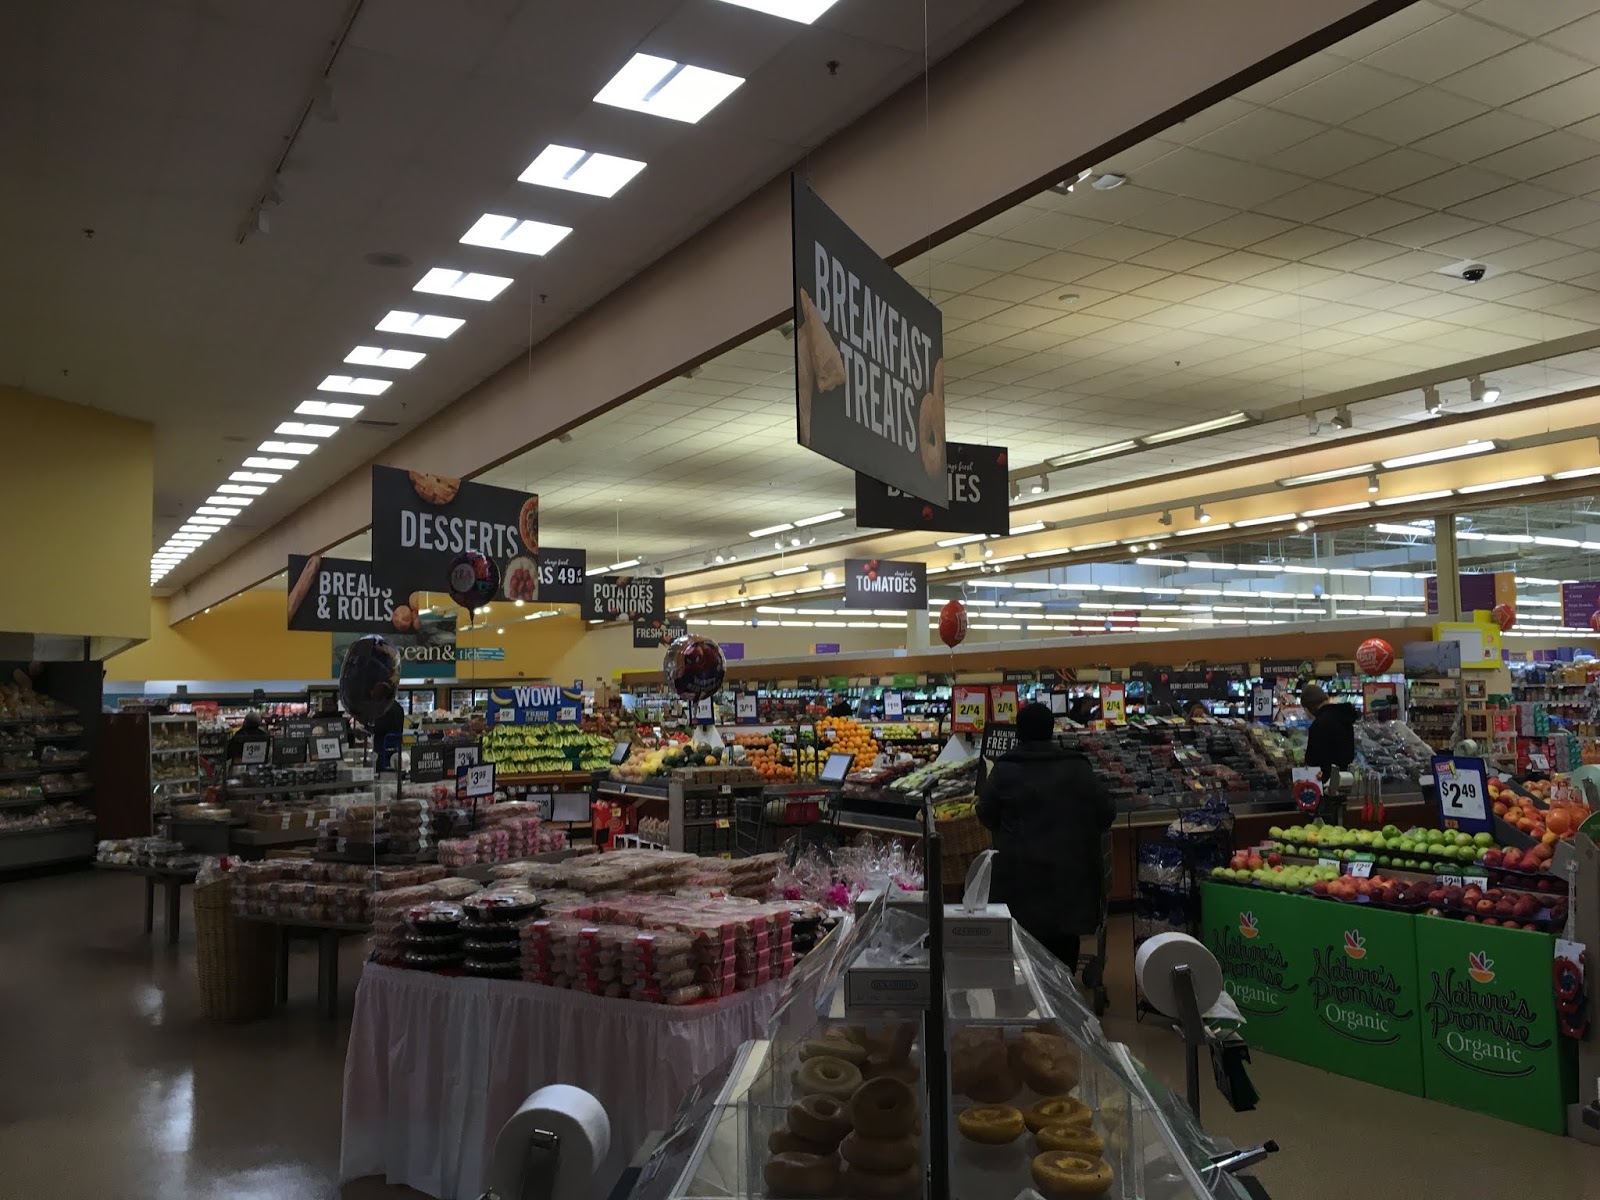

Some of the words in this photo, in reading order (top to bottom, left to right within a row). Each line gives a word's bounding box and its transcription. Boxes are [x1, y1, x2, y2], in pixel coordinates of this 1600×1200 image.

[814, 239, 932, 394] BREAKFAST
[840, 341, 917, 453] TREATS
[401, 510, 519, 559] DESSERTS
[593, 583, 654, 599] POTATOES
[856, 575, 917, 593] TOMATOES
[317, 595, 331, 619] &
[338, 596, 394, 622] ROLLS
[594, 598, 603, 613] &
[607, 598, 654, 614] ONIONS
[636, 628, 660, 639] FRESH
[663, 628, 685, 638] FRUIT
[515, 686, 561, 708] WOW!
[960, 704, 980, 715] 2/$4
[986, 736, 1008, 750] FREE
[1442, 782, 1476, 808] $249
[1213, 925, 1288, 970] Nature's
[1222, 961, 1299, 995] romise
[1313, 945, 1401, 995] Nature's
[1223, 979, 1278, 1005] Organic
[1307, 976, 1413, 1021] Promise
[1431, 967, 1536, 1023] Nature's
[1326, 1003, 1389, 1032] Organic
[1425, 1002, 1552, 1050] Promise
[1446, 1031, 1522, 1063] Organic
